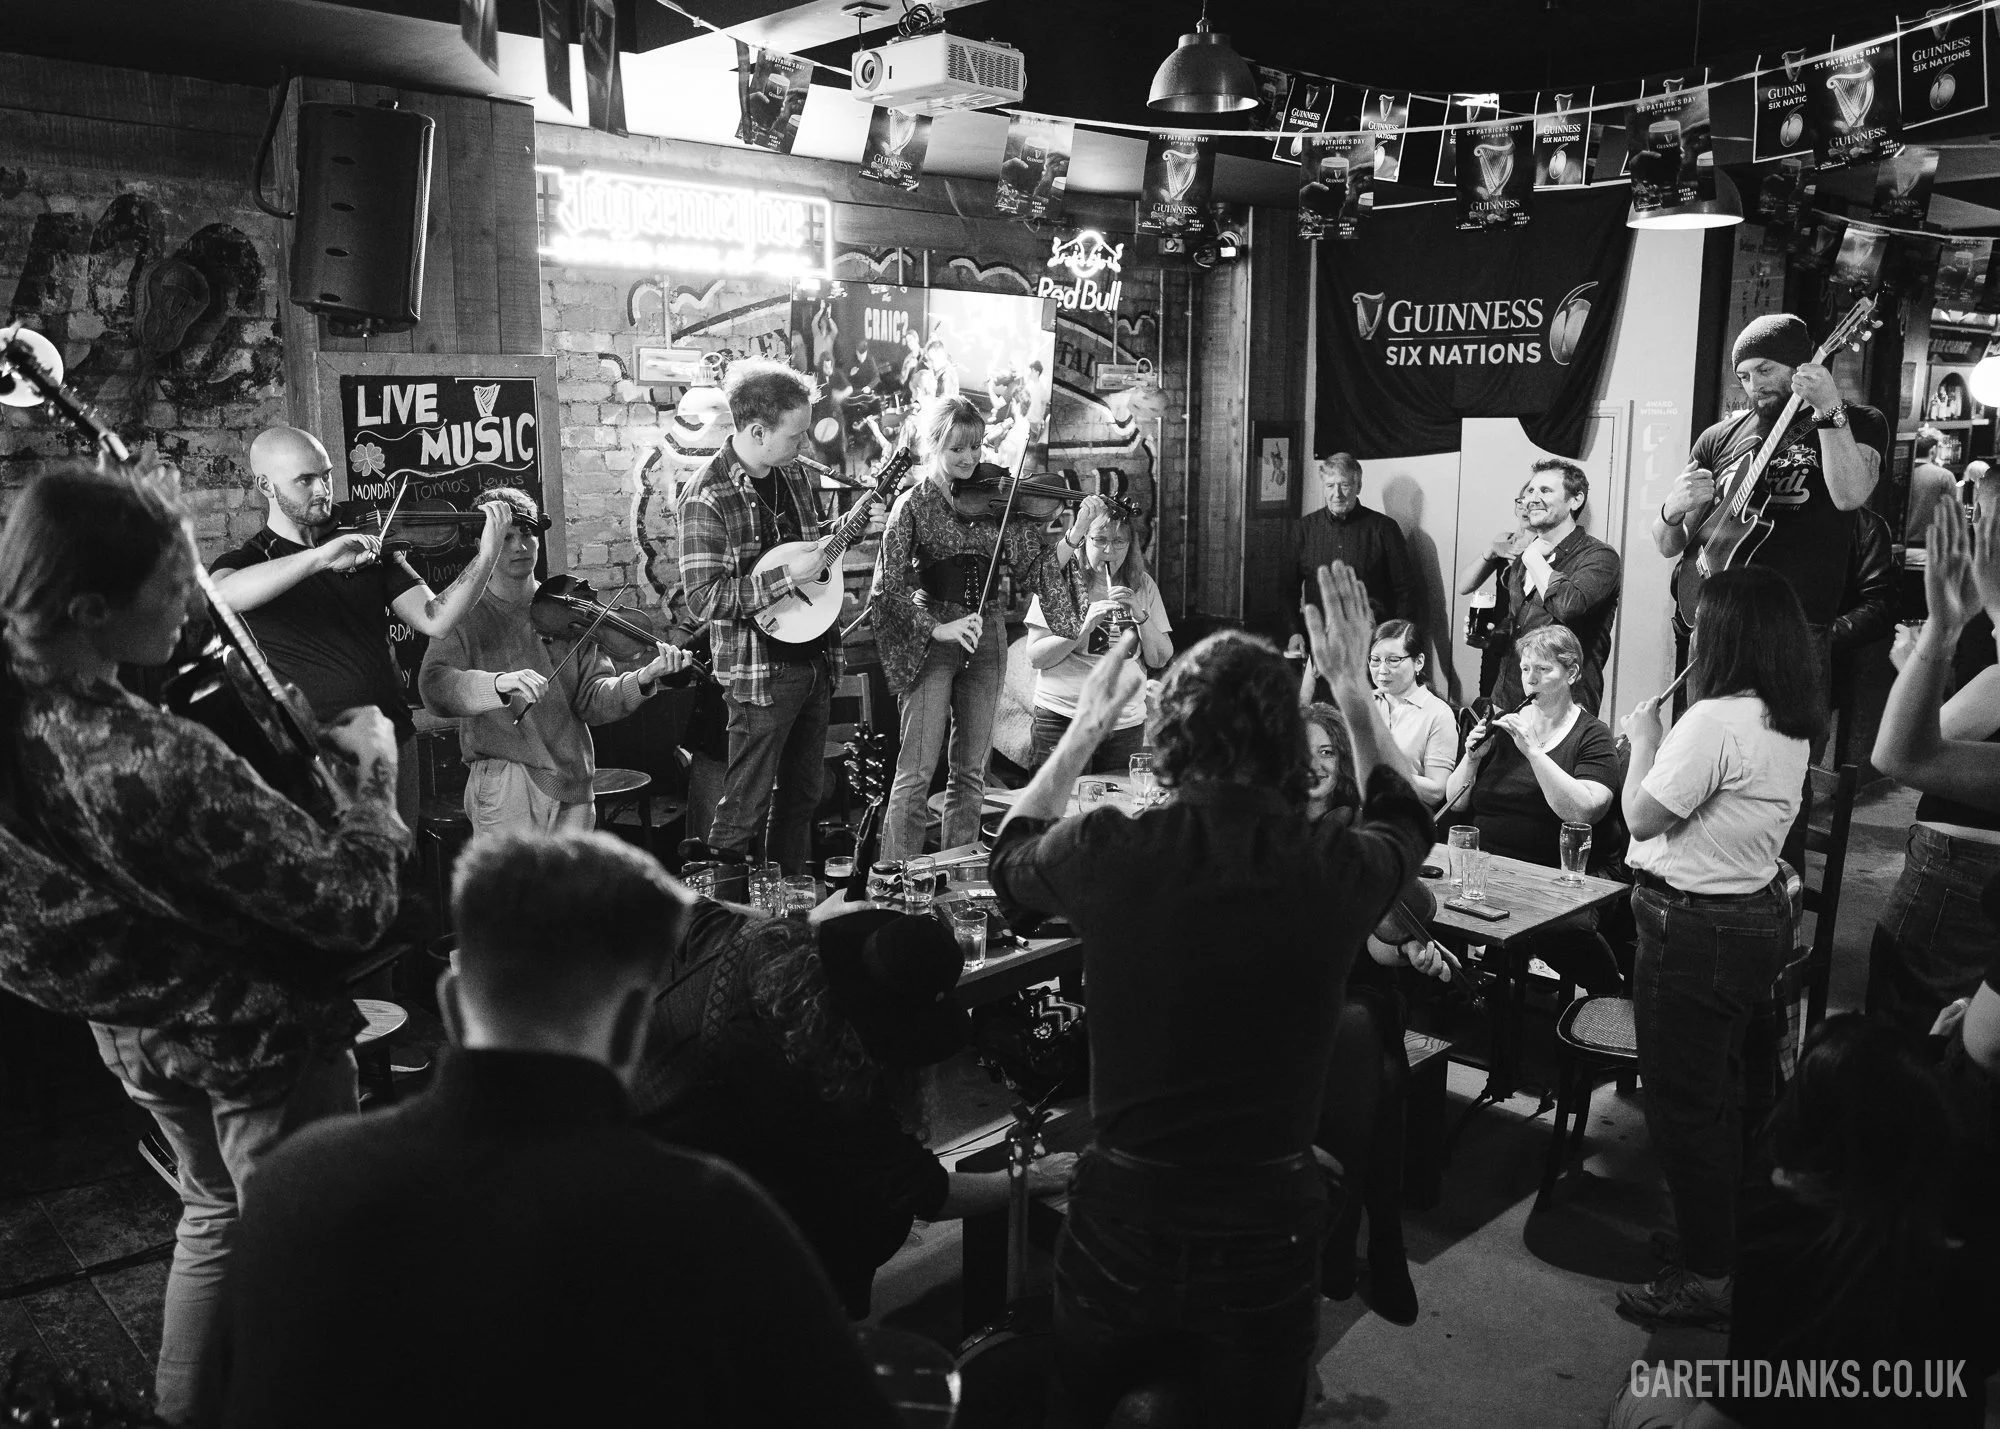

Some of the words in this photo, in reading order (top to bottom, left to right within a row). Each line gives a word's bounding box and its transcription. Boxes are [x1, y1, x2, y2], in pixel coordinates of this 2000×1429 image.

[1866, 46, 1881, 57] DAY
[1911, 36, 1971, 62] GUINNESS
[1913, 62, 1926, 73] SIX
[1927, 49, 1971, 68] NATIONS
[1646, 100, 1682, 112] PATRICK'S
[1683, 96, 1697, 105] DAY
[1768, 101, 1781, 110] SIX
[1291, 107, 1321, 121] GUINNESS
[1298, 119, 1318, 129] NATIONS
[1368, 120, 1399, 131] GUINNESS
[1510, 124, 1523, 132] DAY
[1543, 124, 1581, 135] GUINNESS
[1167, 134, 1198, 142] PATRICK'S
[1553, 135, 1580, 143] NATIONS
[1829, 126, 1887, 148] GUINNESS
[873, 152, 912, 170] GUINNESS
[1153, 202, 1198, 215] GUINNESS
[1470, 199, 1520, 211] GUINNESS
[1038, 276, 1078, 309] Red
[1079, 276, 1122, 312] Bull
[1387, 298, 1544, 334] GUINNESS
[864, 307, 909, 345] CRAIC?
[1386, 345, 1423, 366] SIX
[1429, 343, 1542, 366] NATIONS
[357, 383, 439, 427] LIVE
[420, 412, 536, 467] MUSIC
[405, 477, 470, 501] Tomos
[477, 471, 524, 491] Lewis
